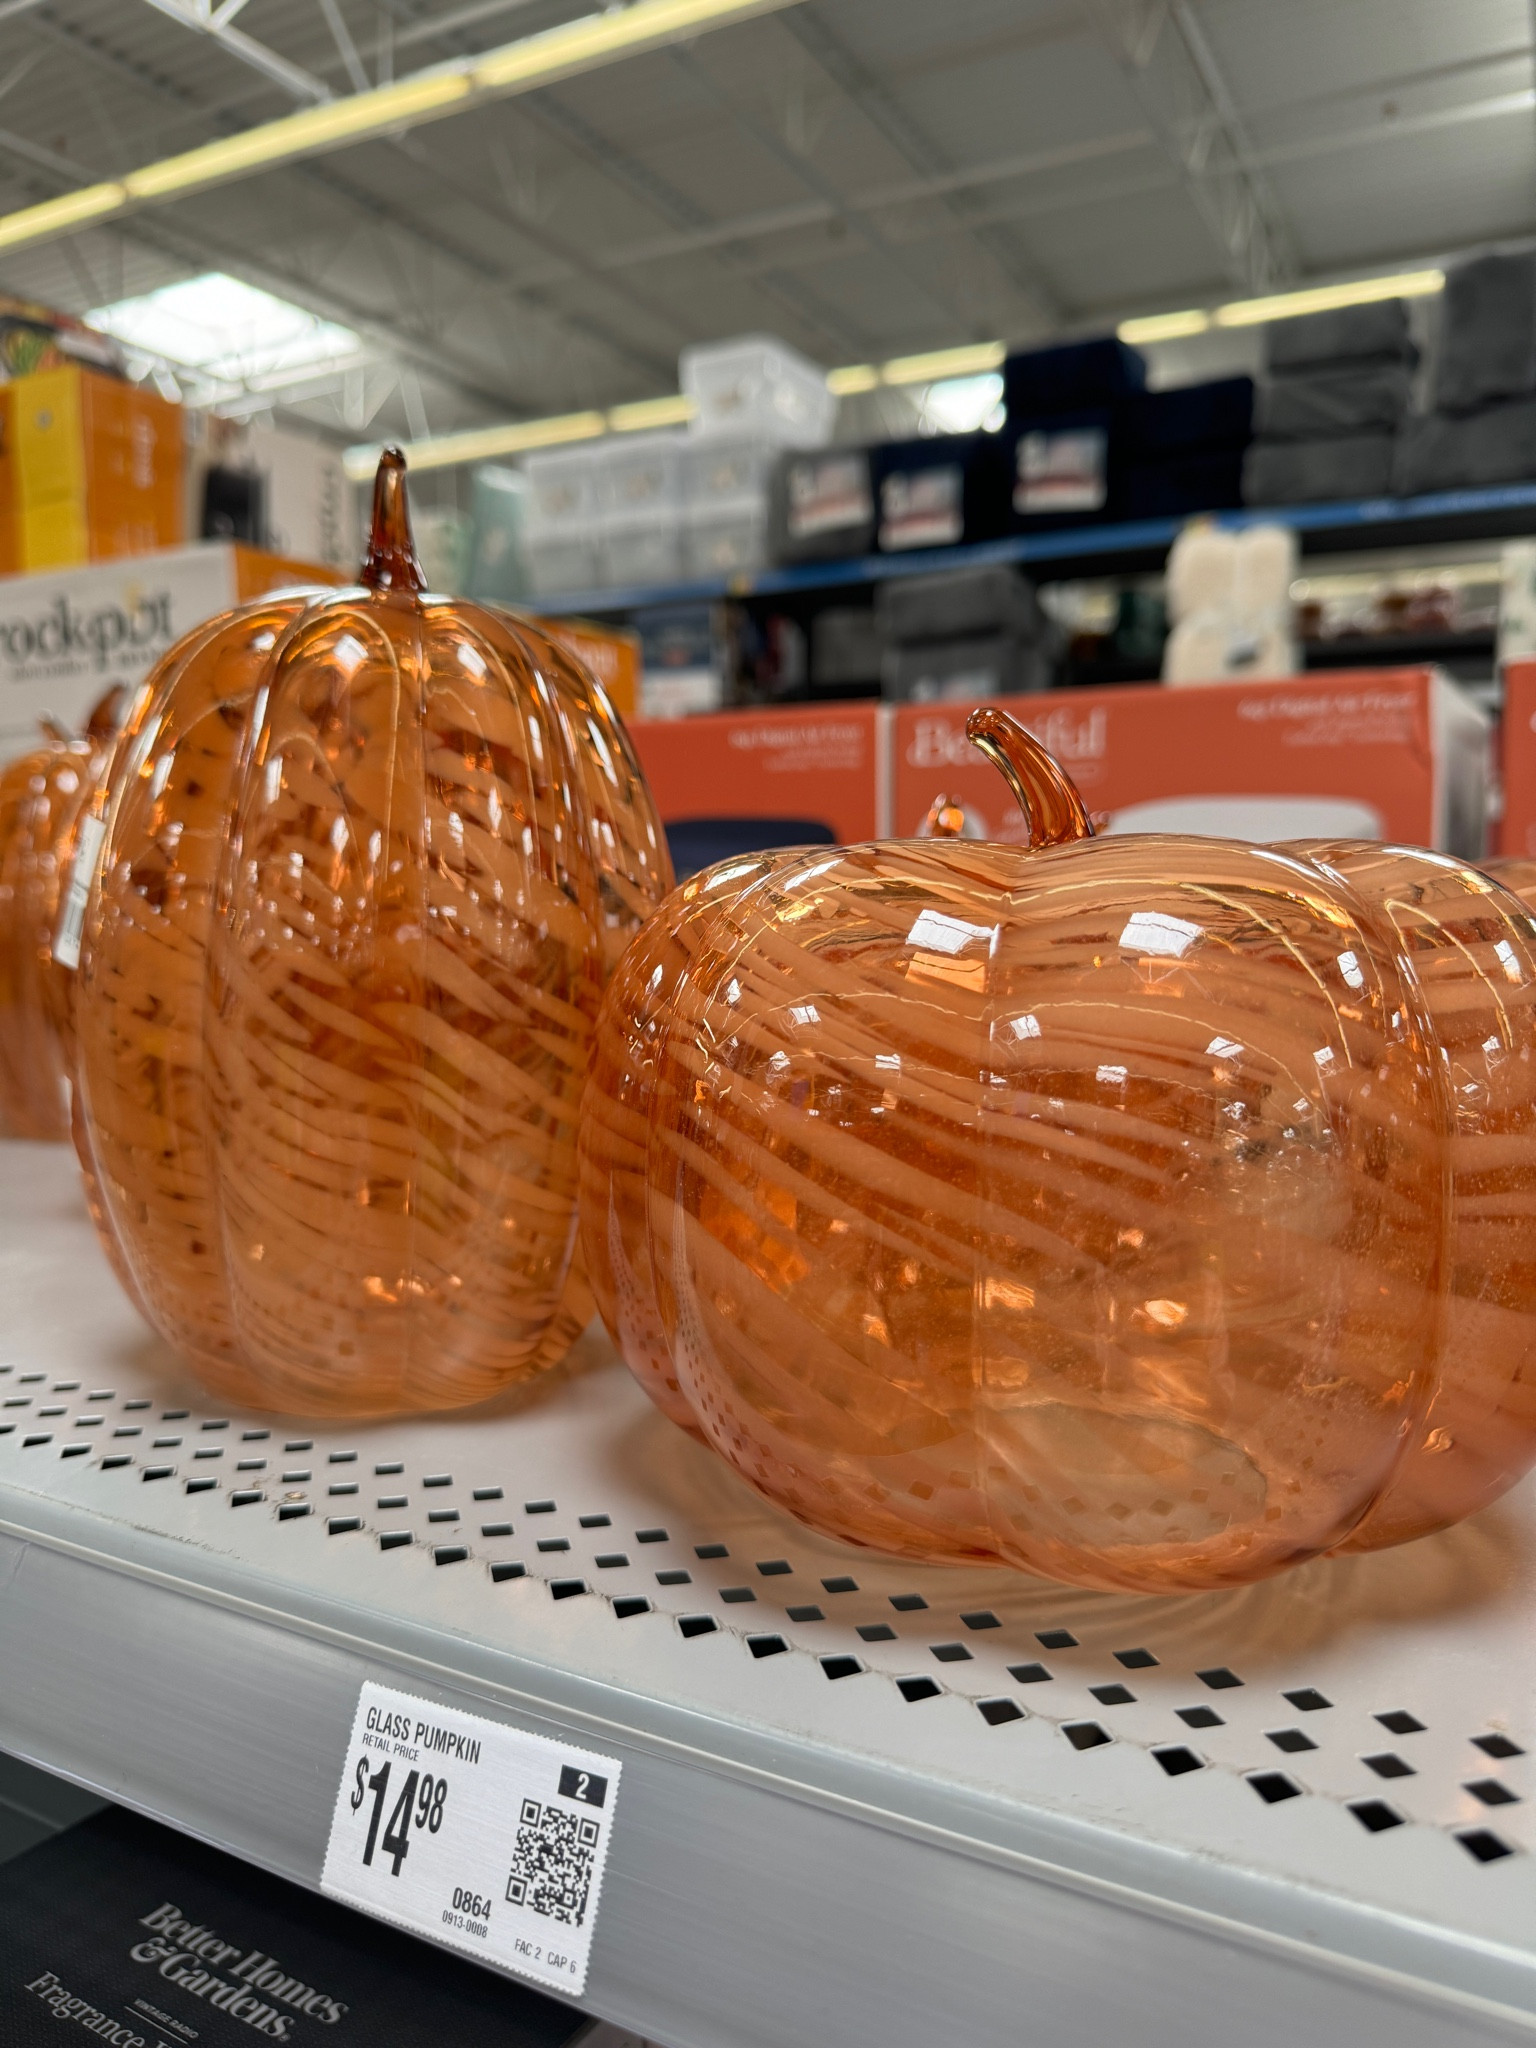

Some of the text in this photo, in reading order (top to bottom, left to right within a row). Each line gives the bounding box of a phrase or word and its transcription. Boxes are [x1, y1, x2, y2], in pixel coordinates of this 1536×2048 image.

[361, 1732, 420, 1762] RETAIL PRICE
[366, 1706, 482, 1765] GLASS PUMPKIN
[576, 1773, 590, 1800] 2
[452, 1887, 492, 1921] 0864
[442, 1910, 488, 1938] 0913-0008
[138, 1902, 349, 2024] Better Homes
[514, 1938, 577, 1974] FAC 2 CAP 6
[24, 1970, 146, 2048] Fragrance
